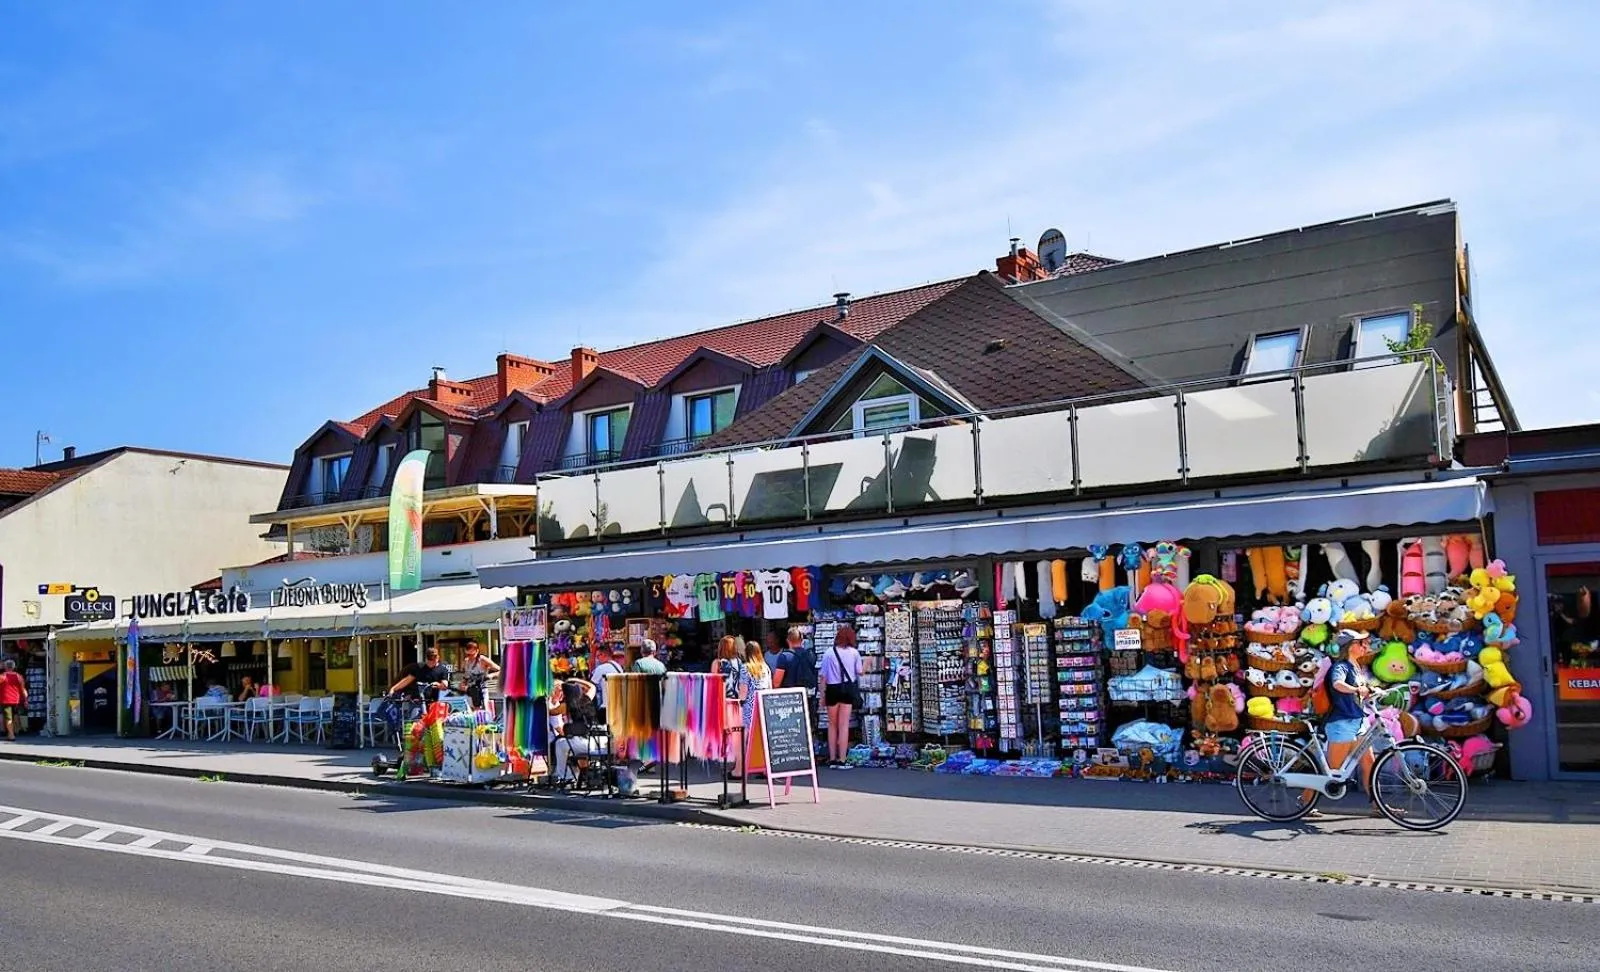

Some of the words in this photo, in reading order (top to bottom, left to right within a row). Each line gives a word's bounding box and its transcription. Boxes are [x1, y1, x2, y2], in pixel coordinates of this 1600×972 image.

[277, 585, 320, 607] ZIELONA
[320, 582, 367, 608] BUDKA
[652, 583, 660, 598] 5
[703, 586, 717, 601] 10
[723, 582, 736, 599] 10
[744, 583, 755, 599] 10
[768, 585, 783, 604] 10
[802, 578, 811, 596] 9
[70, 600, 112, 612] OLECKI
[128, 589, 199, 619] JUNGLA
[205, 586, 248, 614] Cafe
[1568, 679, 1600, 688] KEBA
